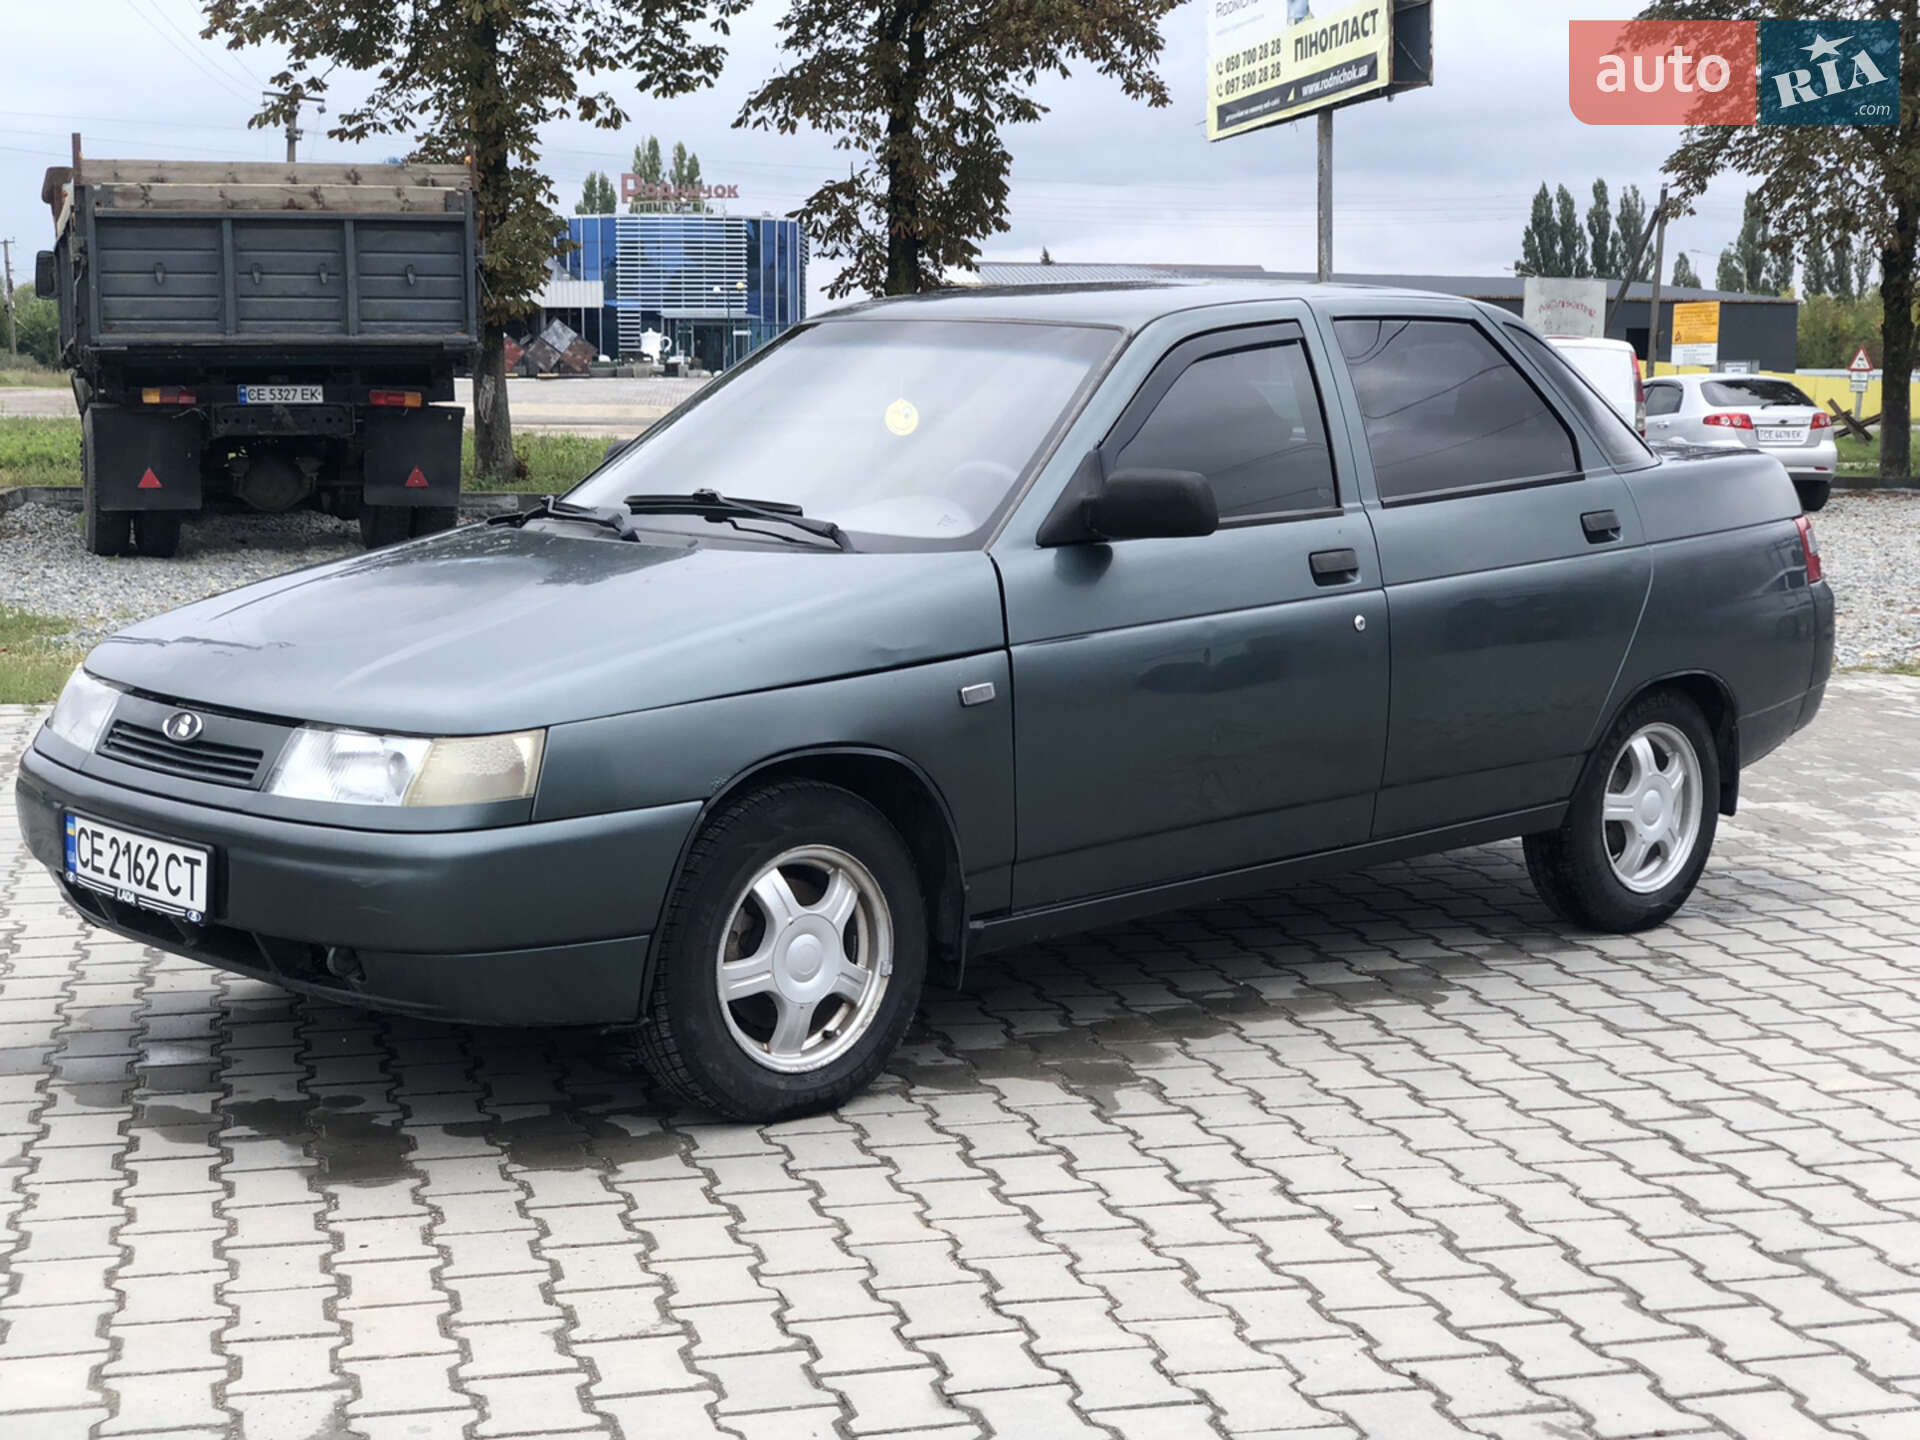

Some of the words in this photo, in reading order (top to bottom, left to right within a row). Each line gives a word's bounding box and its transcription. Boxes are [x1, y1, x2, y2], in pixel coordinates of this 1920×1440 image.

[1294, 8, 1379, 63] ПІНОПЛАСТ
[1225, 53, 1241, 73] 050
[1242, 47, 1257, 67] 700
[1258, 42, 1269, 61] 28
[1270, 38, 1281, 56] 28
[1225, 76, 1240, 95] 097
[1242, 70, 1257, 90] 500
[1258, 65, 1269, 84] 28
[1270, 61, 1281, 79] 28
[1302, 64, 1369, 96] www.rodnichok.ua
[247, 388, 266, 401] CE
[269, 388, 298, 401] 5327
[300, 388, 319, 401] EK
[76, 826, 105, 876] CE
[108, 836, 159, 892] 2162
[164, 852, 202, 902] CT
